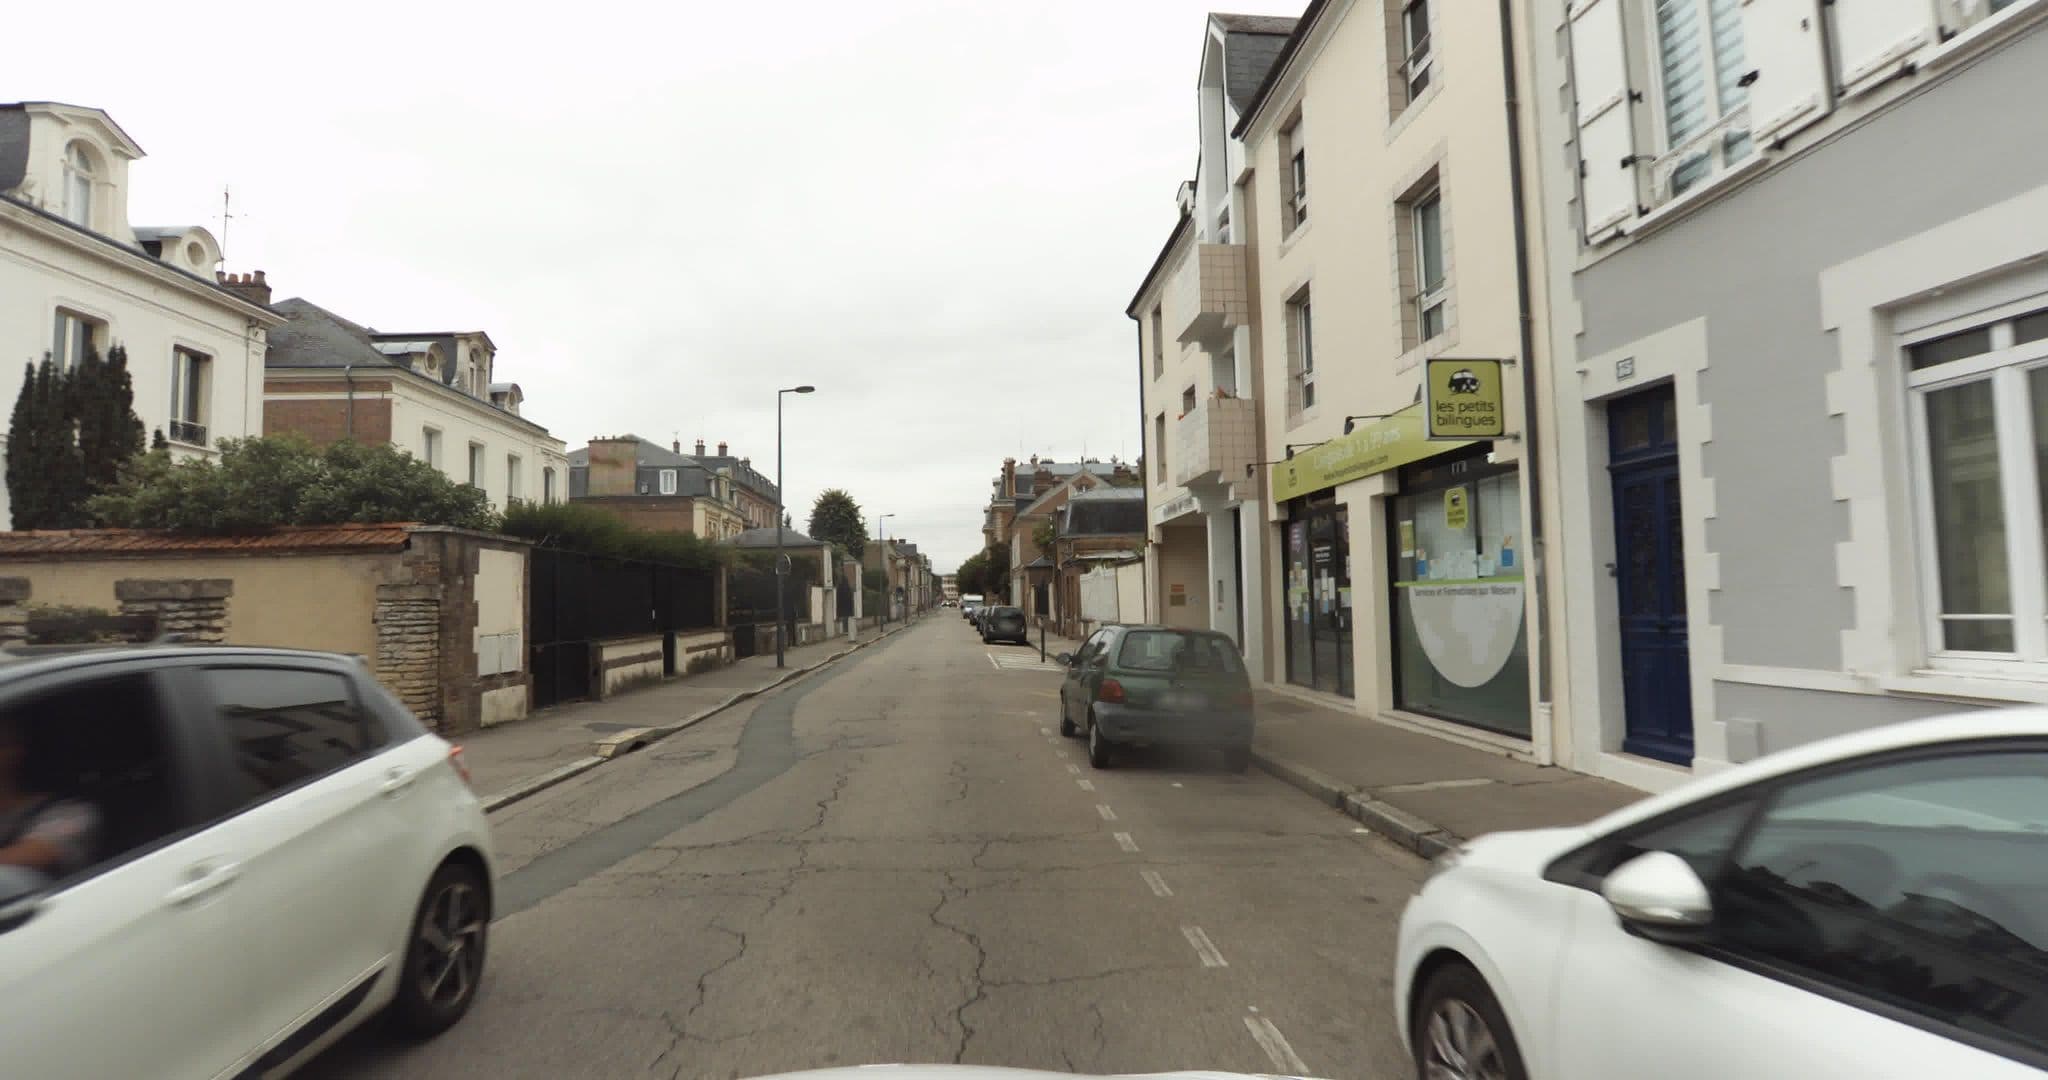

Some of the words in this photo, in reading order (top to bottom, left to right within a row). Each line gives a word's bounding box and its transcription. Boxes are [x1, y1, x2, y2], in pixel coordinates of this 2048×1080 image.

[1436, 400, 1454, 412] les
[1458, 400, 1495, 414] petits
[1437, 414, 1496, 428] bilingues
